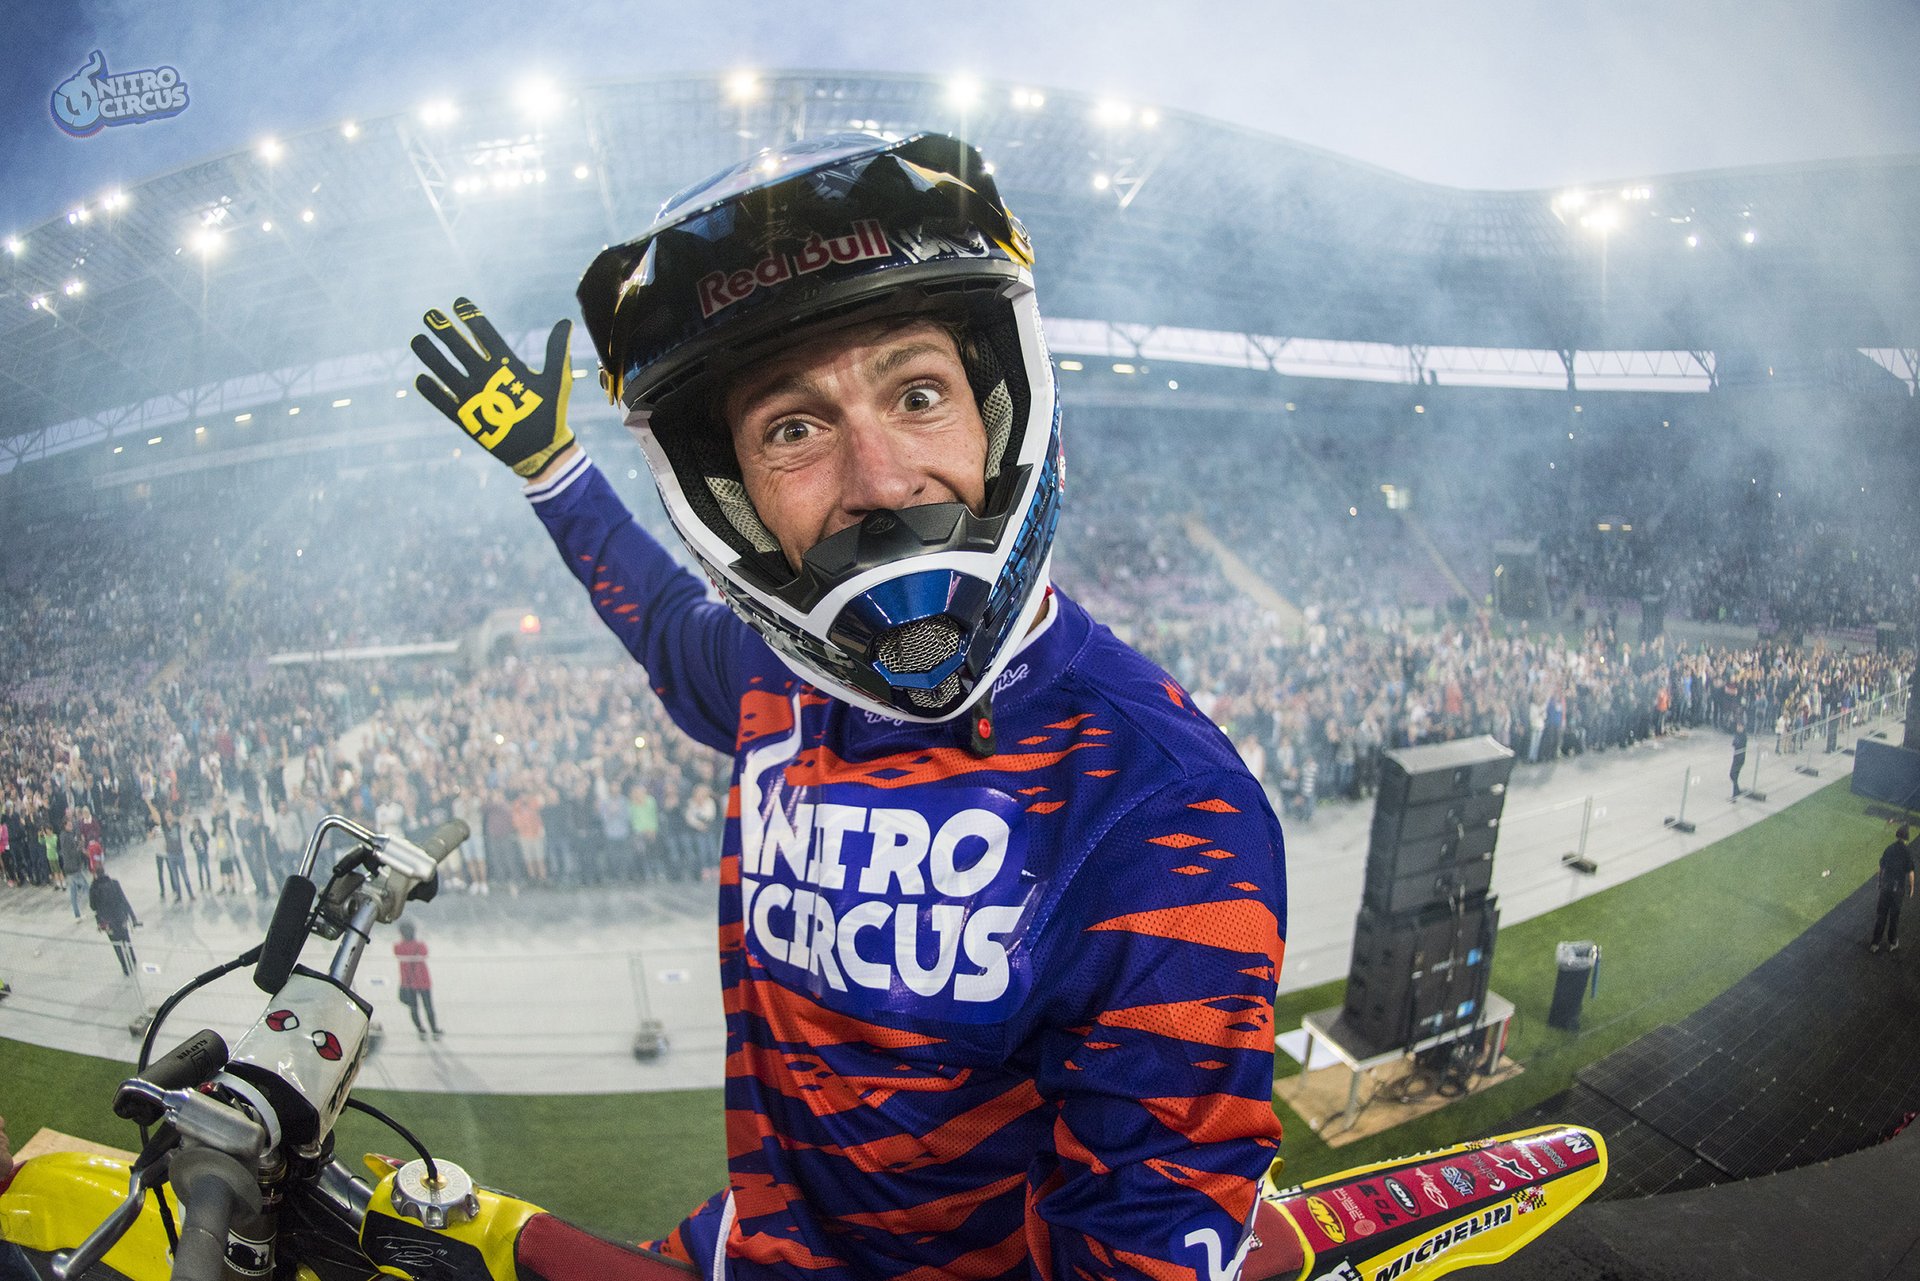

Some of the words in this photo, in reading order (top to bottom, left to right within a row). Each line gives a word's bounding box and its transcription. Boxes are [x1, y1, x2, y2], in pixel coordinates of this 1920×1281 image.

[697, 250, 792, 319] Red
[794, 219, 892, 276] Bull
[760, 796, 1010, 898] NITRO
[753, 883, 1025, 1003] CIRCUS
[1307, 1197, 1346, 1243] FMF
[1375, 1203, 1512, 1281] MICHELIN
